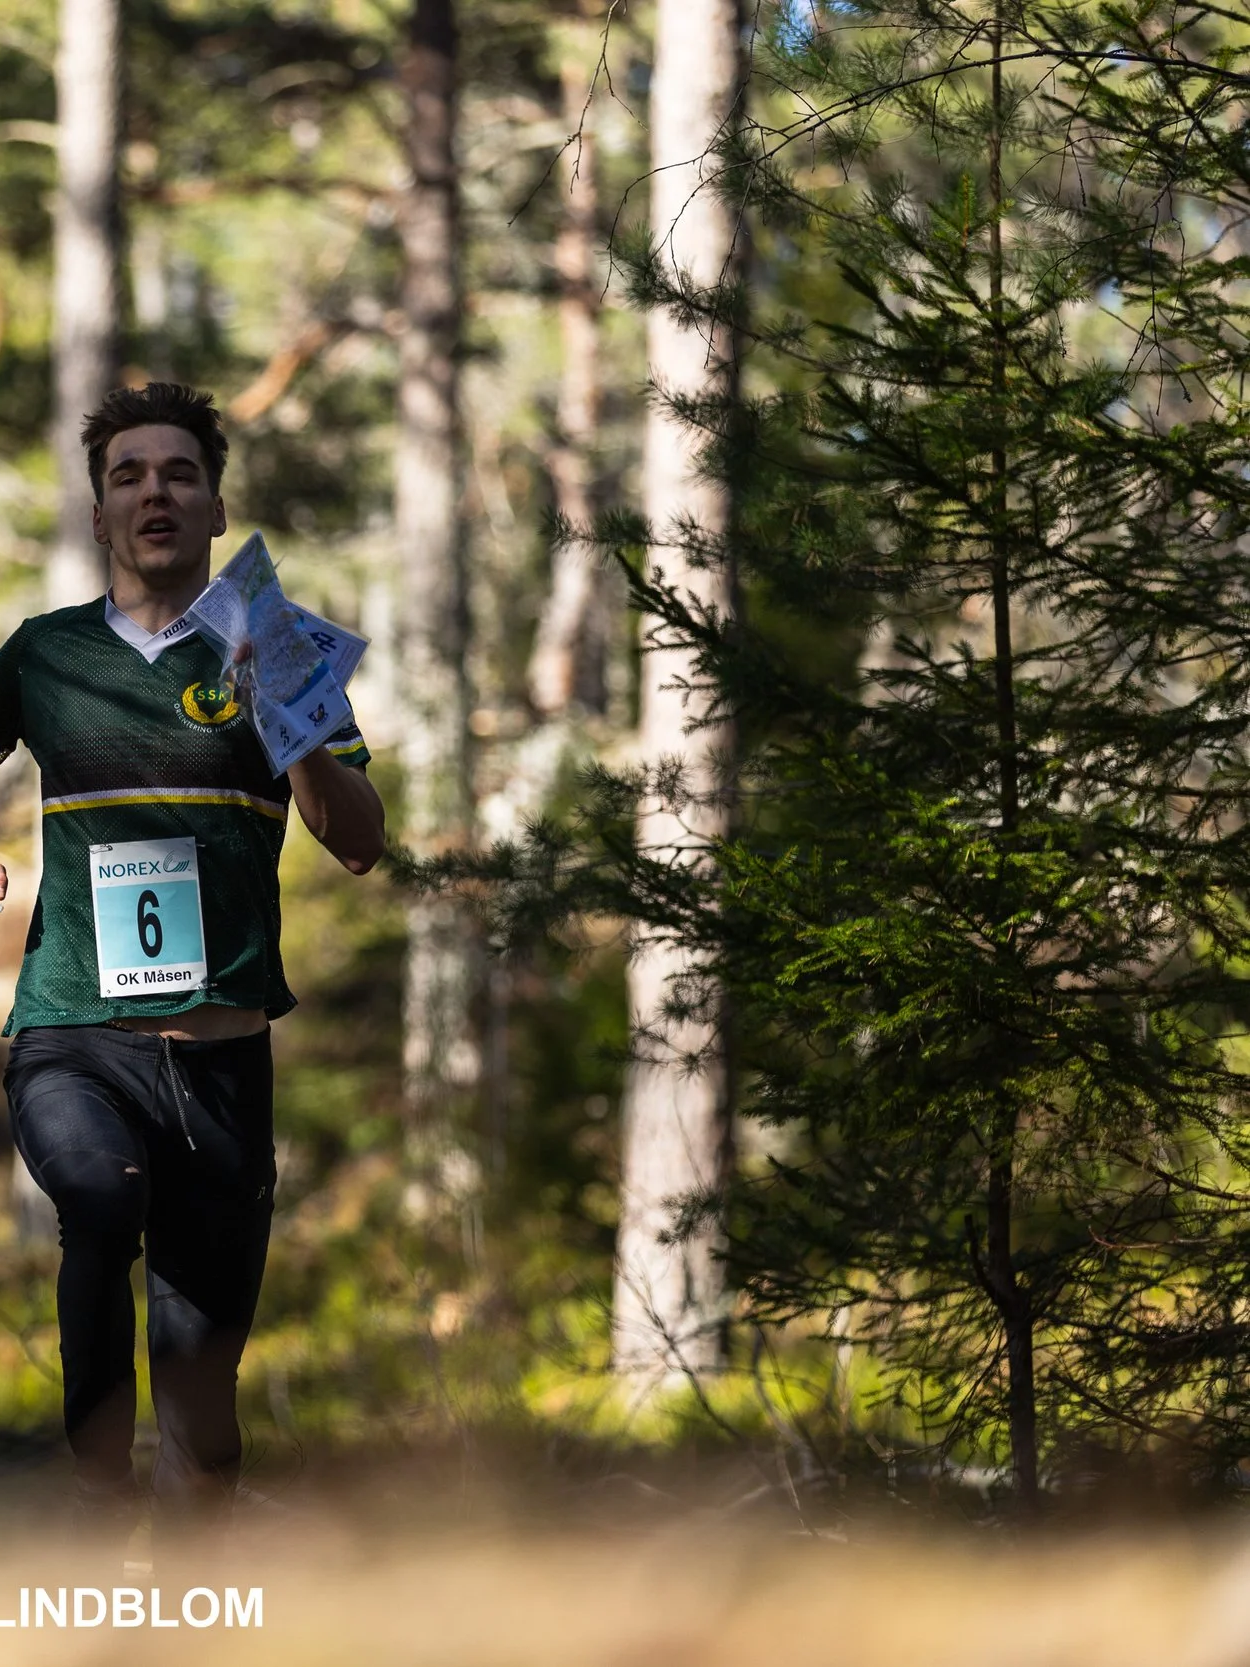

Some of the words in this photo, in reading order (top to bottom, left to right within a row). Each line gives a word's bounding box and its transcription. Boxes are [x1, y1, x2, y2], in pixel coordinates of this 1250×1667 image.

[173, 702, 212, 734] ORIENTERING
[98, 860, 161, 879] NOREX
[137, 889, 163, 959] 6
[116, 972, 140, 986] OK
[144, 969, 192, 985] Måsen
